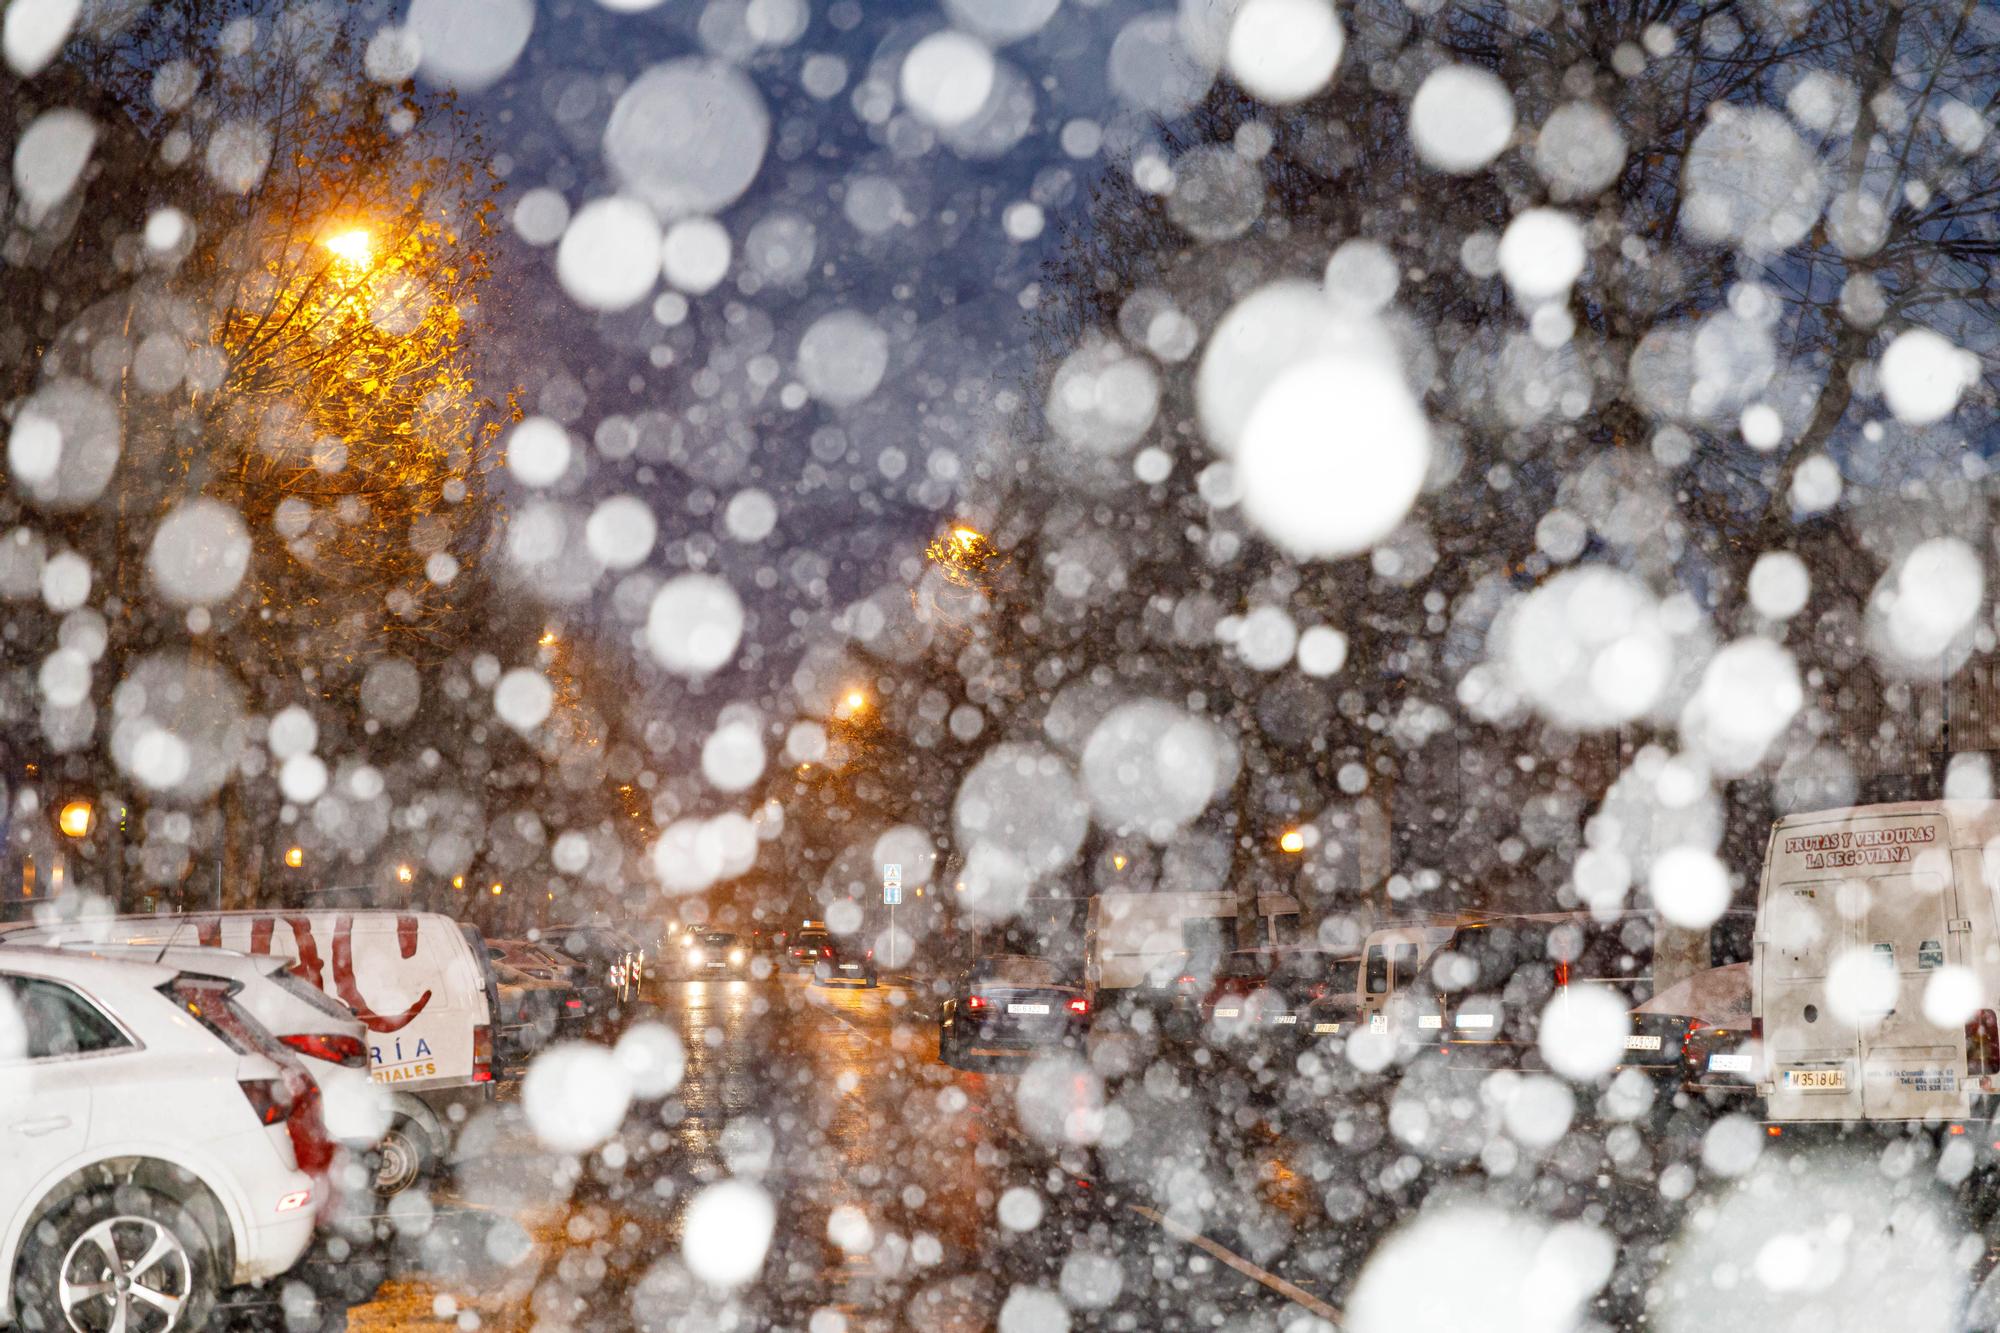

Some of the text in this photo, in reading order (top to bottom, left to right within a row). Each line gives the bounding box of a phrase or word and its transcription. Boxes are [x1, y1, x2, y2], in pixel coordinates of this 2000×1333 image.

[1785, 826, 1935, 854] FRUTAS Y VERDURAS
[1806, 846, 1911, 869] LA SEGOVIANA
